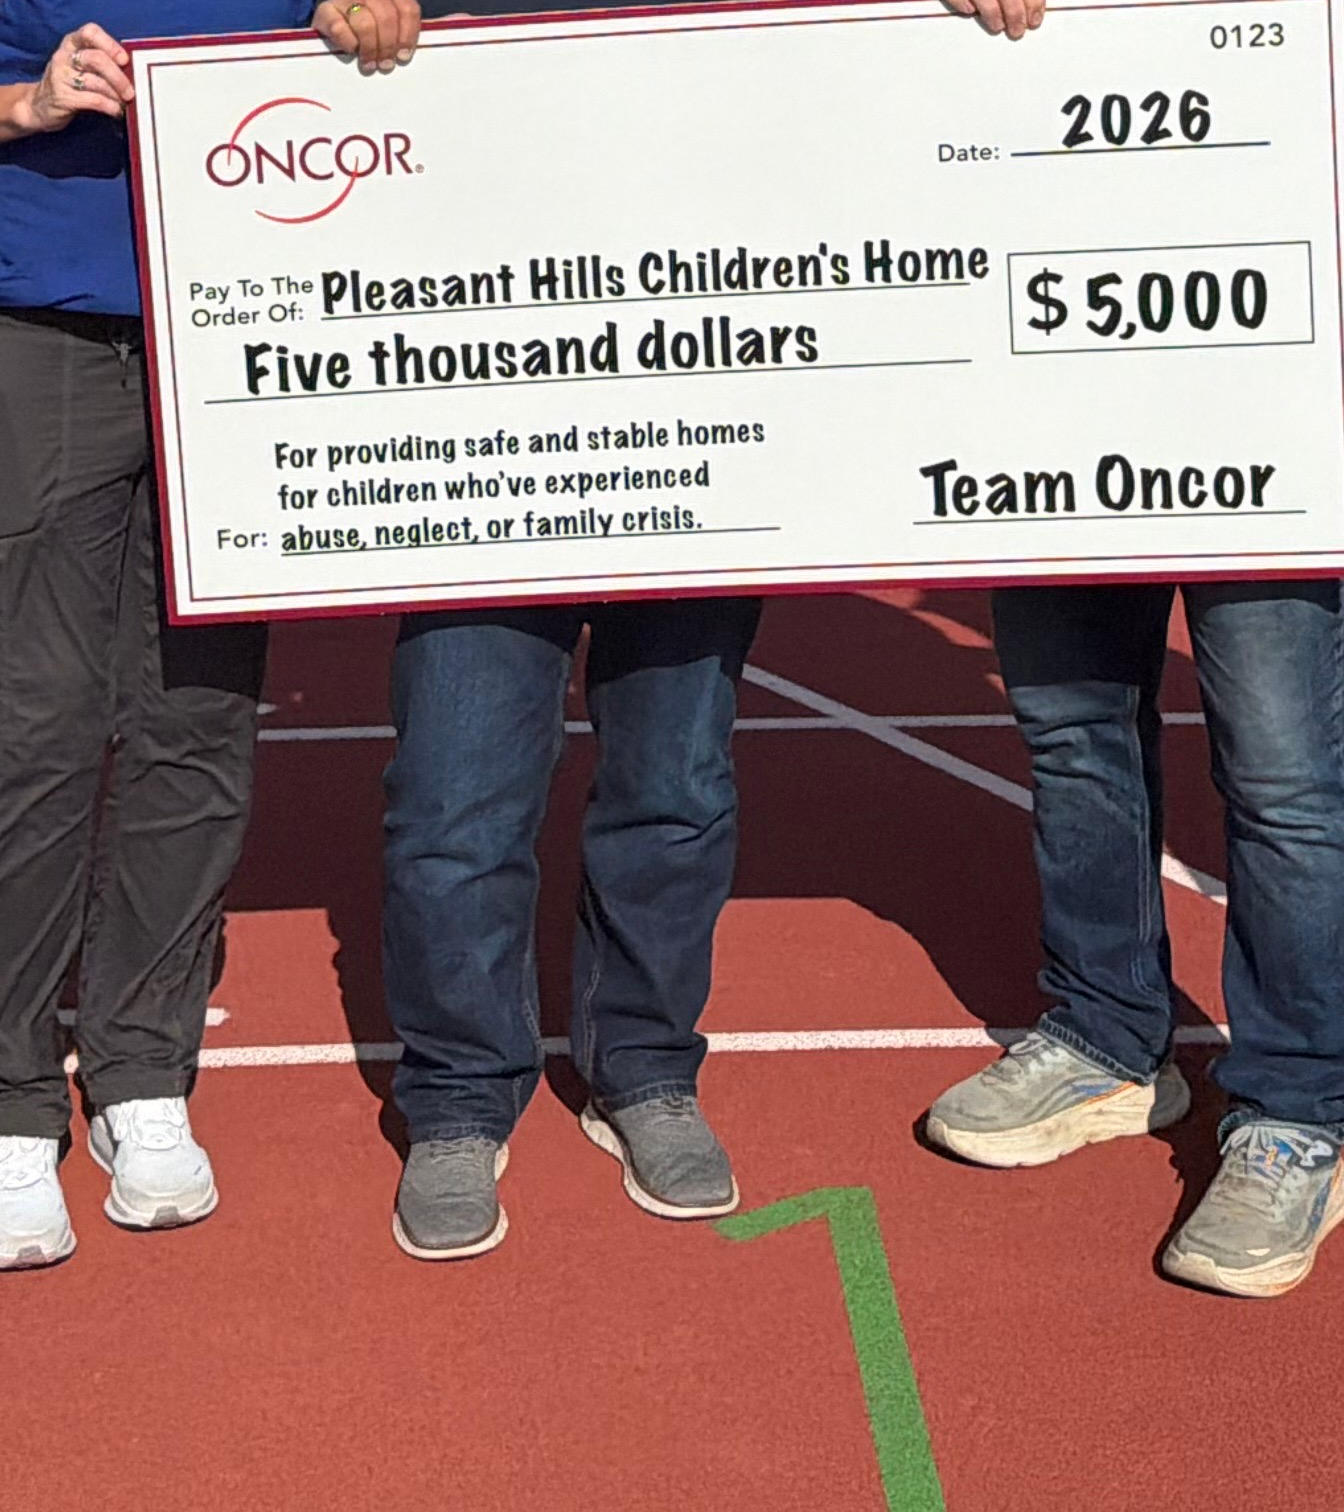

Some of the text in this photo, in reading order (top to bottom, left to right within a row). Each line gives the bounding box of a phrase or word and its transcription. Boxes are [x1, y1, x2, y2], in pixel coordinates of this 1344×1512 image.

[1211, 23, 1284, 49] 0123
[1061, 90, 1210, 147] 2026
[206, 132, 412, 186] ONCOR
[939, 144, 1000, 162] Date:
[190, 276, 313, 304] Pay To The
[322, 240, 989, 313] Pleasant Hills Children's Home
[192, 301, 302, 327] Order Of:
[1027, 268, 1267, 339] $ 5,000
[244, 315, 819, 394] Five thousand dollars
[275, 419, 764, 471] For providing safe and stable homes
[278, 460, 709, 510] for children who've experienced
[920, 455, 1274, 515] Team Oncor
[218, 529, 268, 549] For:
[282, 505, 701, 552] abuse, neglect, or family crisis.
